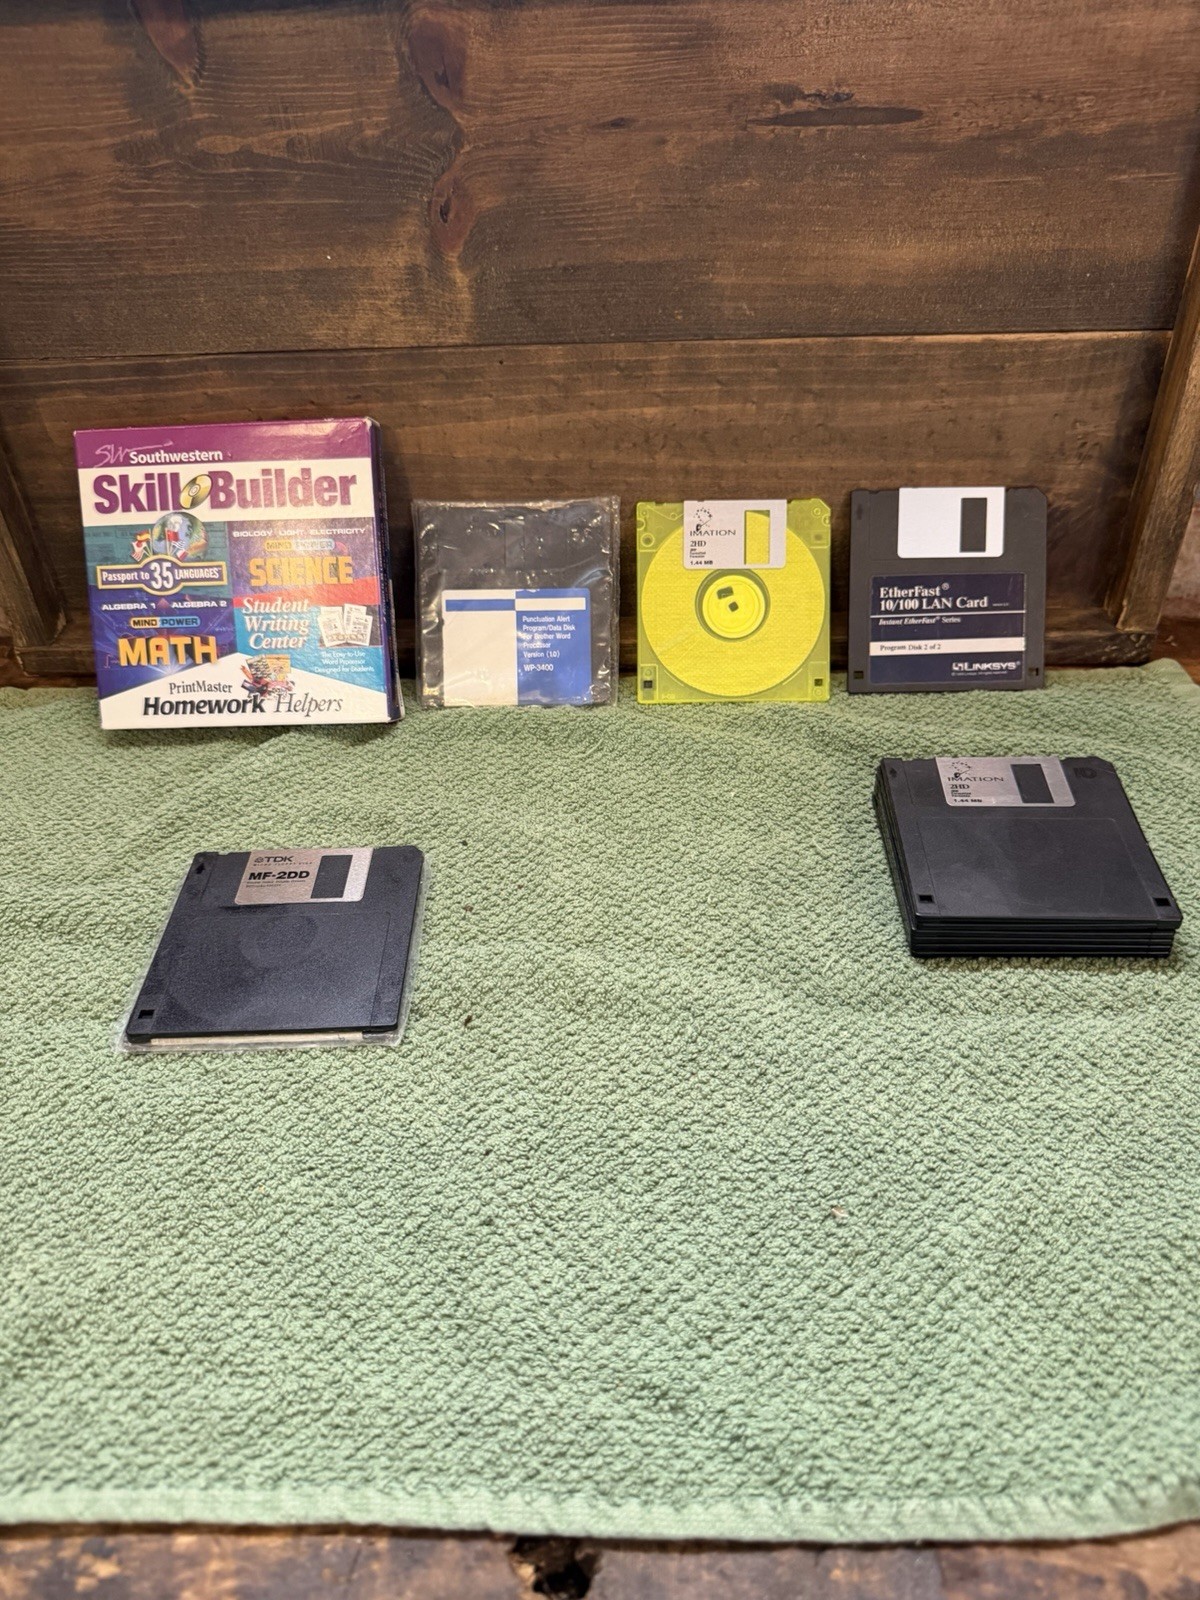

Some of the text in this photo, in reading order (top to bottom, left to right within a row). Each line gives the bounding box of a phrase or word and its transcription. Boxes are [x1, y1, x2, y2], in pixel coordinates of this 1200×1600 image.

[129, 450, 223, 465] Southwestern
[93, 467, 357, 514] Skill Builder
[232, 527, 366, 538] BIOLOGY LIGHT ELECTRICITY
[689, 529, 736, 537] IMATION
[102, 571, 138, 583] Passport
[141, 570, 150, 580] to
[150, 561, 174, 589] 35
[249, 555, 354, 587] SCIENCE
[101, 603, 147, 611] ALGEBRA
[171, 600, 218, 608] ALGEBRA
[242, 597, 310, 614] Student
[880, 596, 988, 612] 10/100 LAN Card
[132, 617, 199, 627] MIND POWER
[243, 615, 310, 635] Writing
[522, 624, 562, 632] Program/Data
[878, 618, 903, 626] Instant
[941, 616, 962, 624] Series
[249, 633, 307, 649] Center
[555, 632, 571, 640] Word
[117, 635, 218, 667] MATH
[523, 650, 545, 659] Version
[523, 663, 554, 671] WP-3400
[169, 680, 233, 695] PrintMaster
[143, 692, 344, 717] Homework Helpers
[249, 871, 310, 880] MF-2DD
